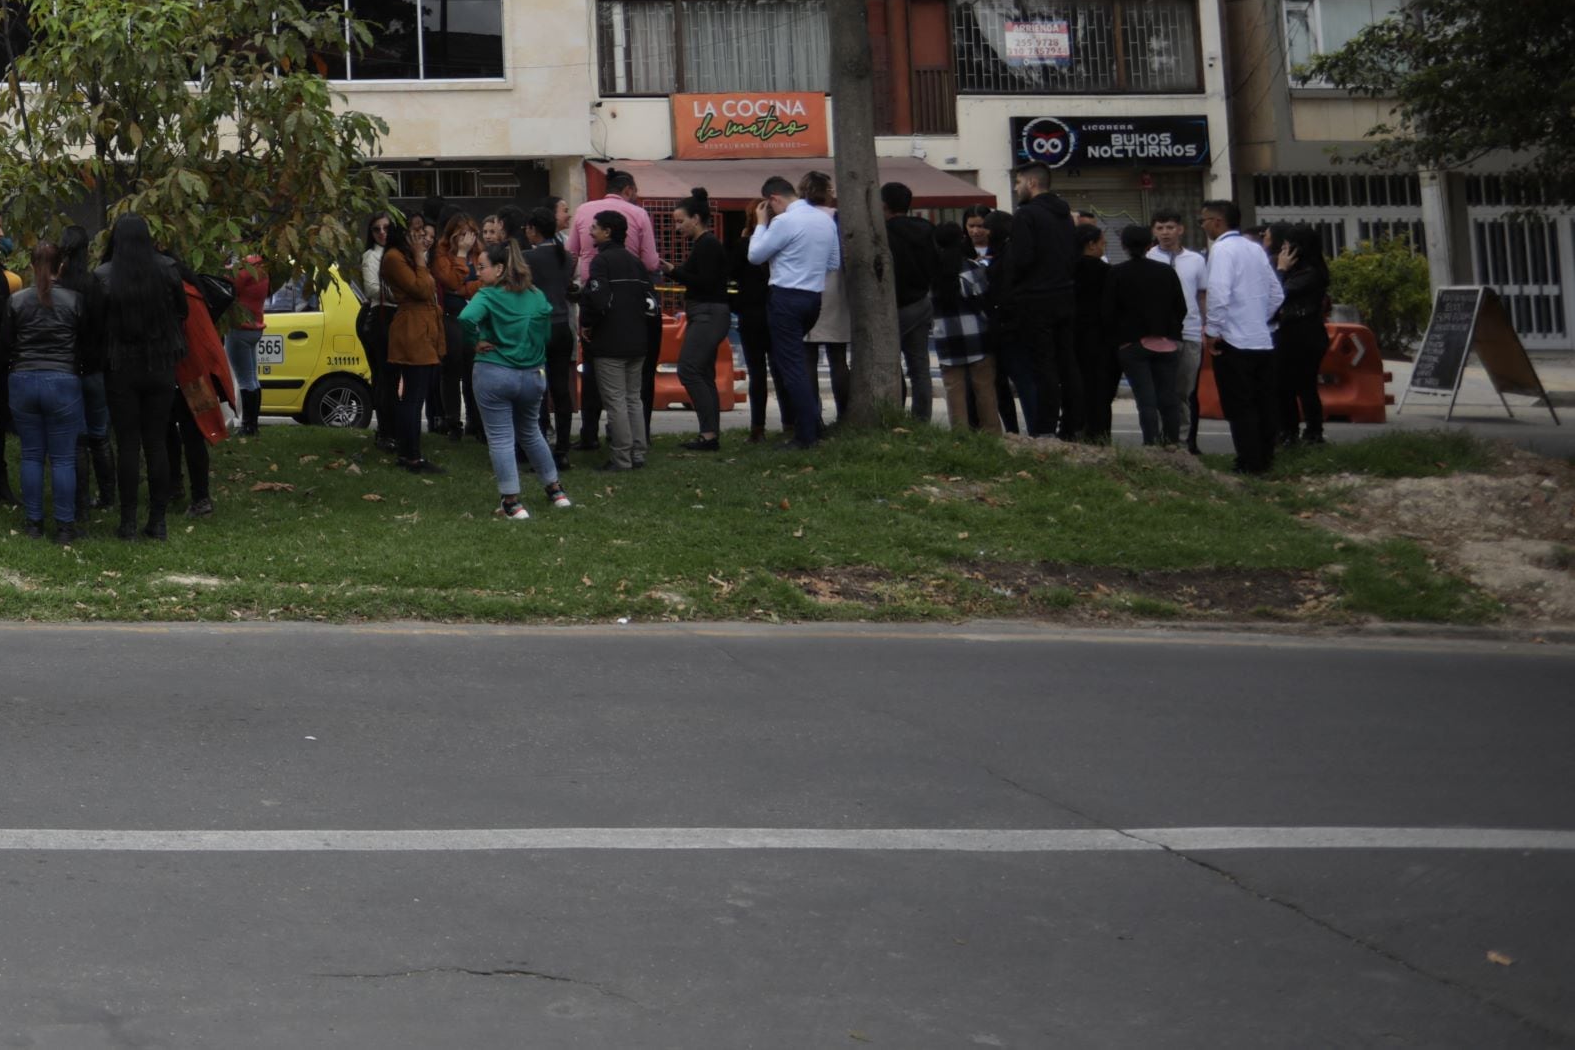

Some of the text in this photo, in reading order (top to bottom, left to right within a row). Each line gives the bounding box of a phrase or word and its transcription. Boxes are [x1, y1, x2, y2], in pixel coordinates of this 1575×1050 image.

[1013, 24, 1060, 32] ARRIENDA
[693, 99, 807, 118] LA COCINA
[695, 106, 809, 143] de mateo
[1087, 144, 1197, 158] NOCTURNOS
[258, 340, 281, 354] 565
